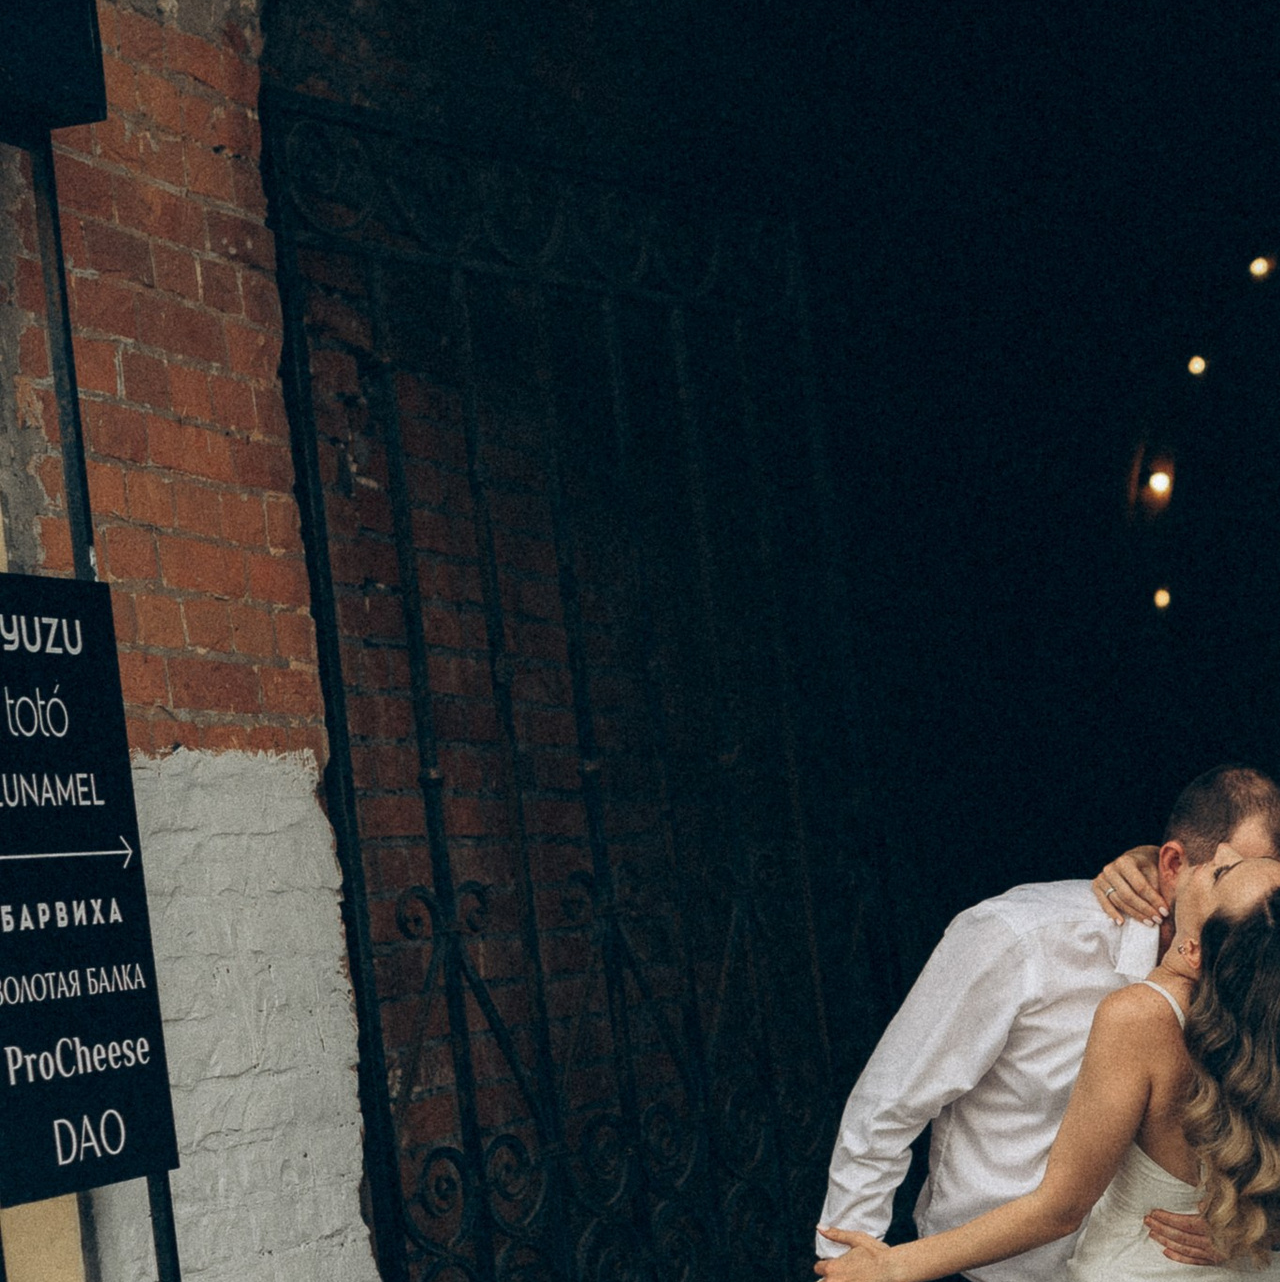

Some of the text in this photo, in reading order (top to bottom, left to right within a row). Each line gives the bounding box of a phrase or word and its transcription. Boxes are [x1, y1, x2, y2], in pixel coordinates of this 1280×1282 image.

[4, 684, 68, 737] totó
[0, 897, 123, 932] БАРВИХА
[86, 963, 146, 995] БАЛКА
[4, 1037, 150, 1085] ProCheese
[53, 1108, 126, 1166] DAO
